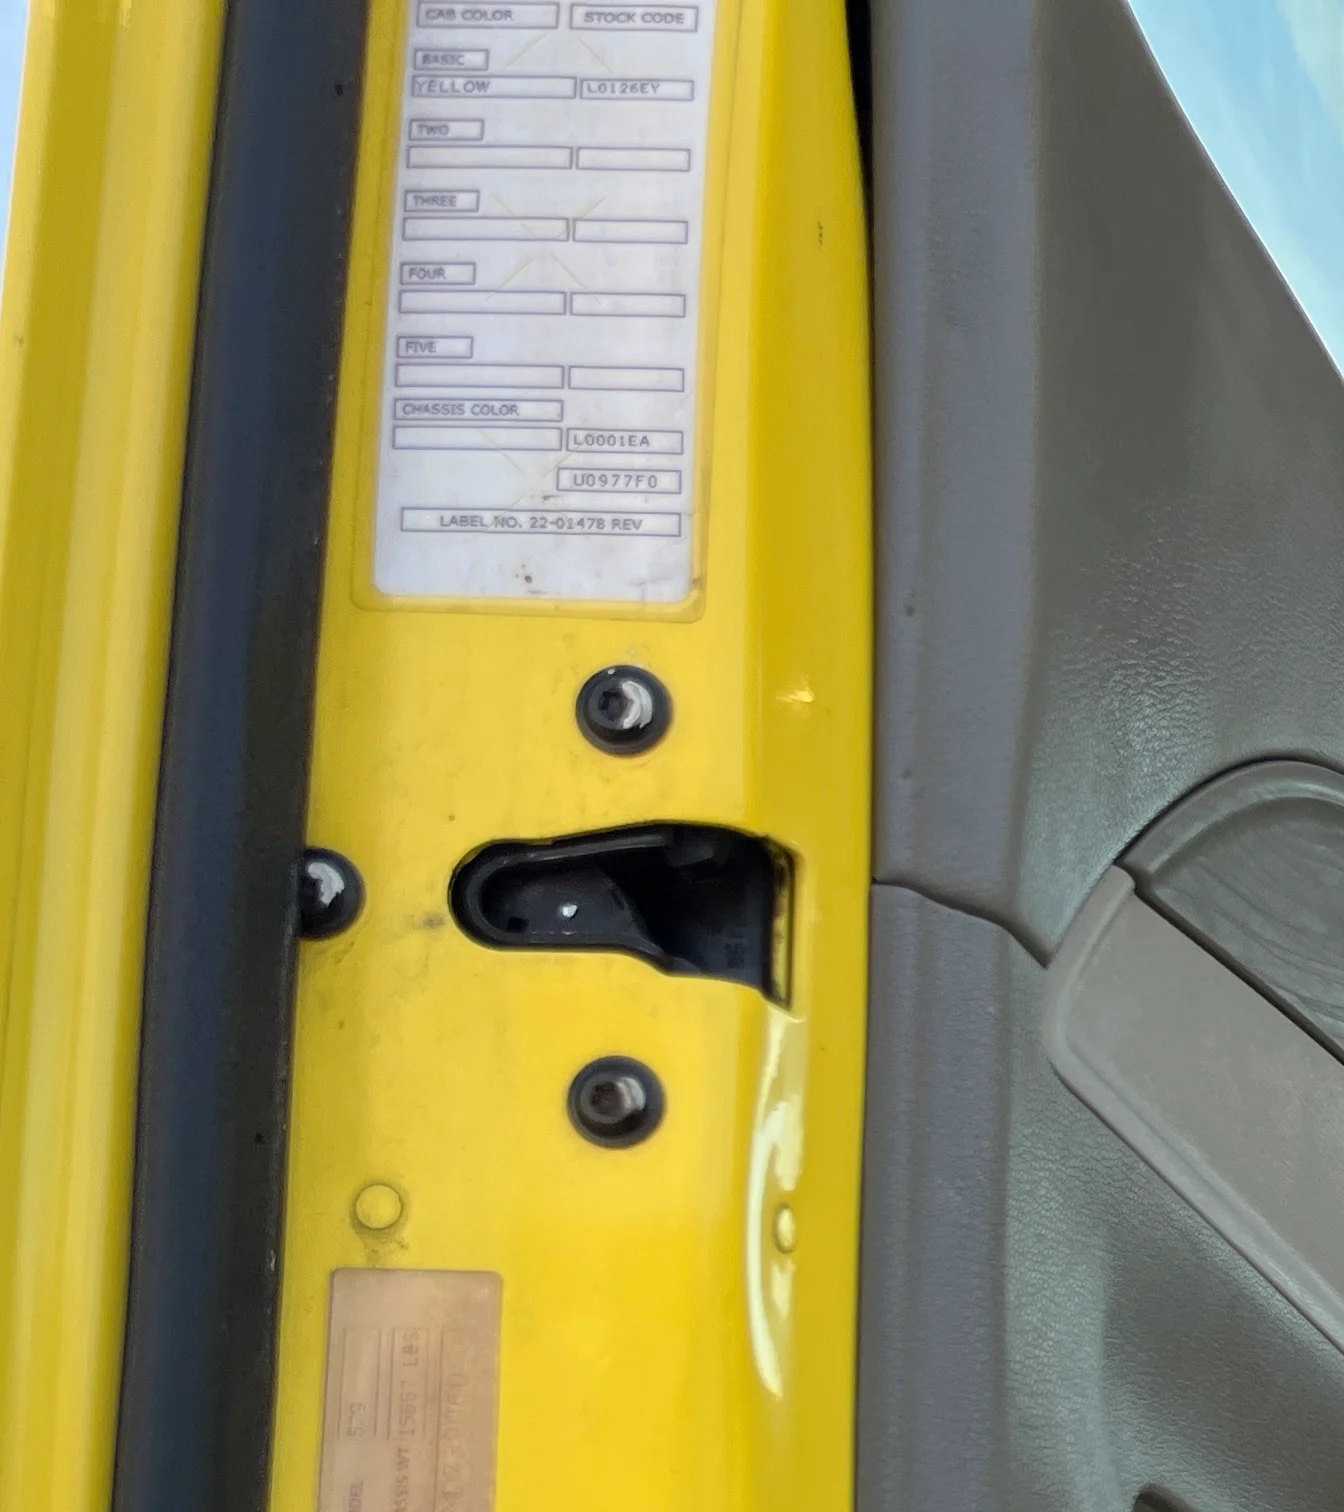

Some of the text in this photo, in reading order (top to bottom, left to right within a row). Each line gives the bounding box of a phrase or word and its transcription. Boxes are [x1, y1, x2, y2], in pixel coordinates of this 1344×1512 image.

[425, 9, 513, 22] CAB COLOR
[584, 12, 685, 24] STOCK CODE
[422, 53, 465, 66] BASIC
[416, 80, 491, 94] YELLOW
[417, 123, 449, 136] TWO
[412, 195, 457, 208] THREE
[409, 267, 446, 280] FOUR
[405, 341, 437, 354] FIVE
[402, 403, 520, 417] CHASSIS COLOR
[440, 515, 643, 532] LABEL NO. 22-01478 REV
